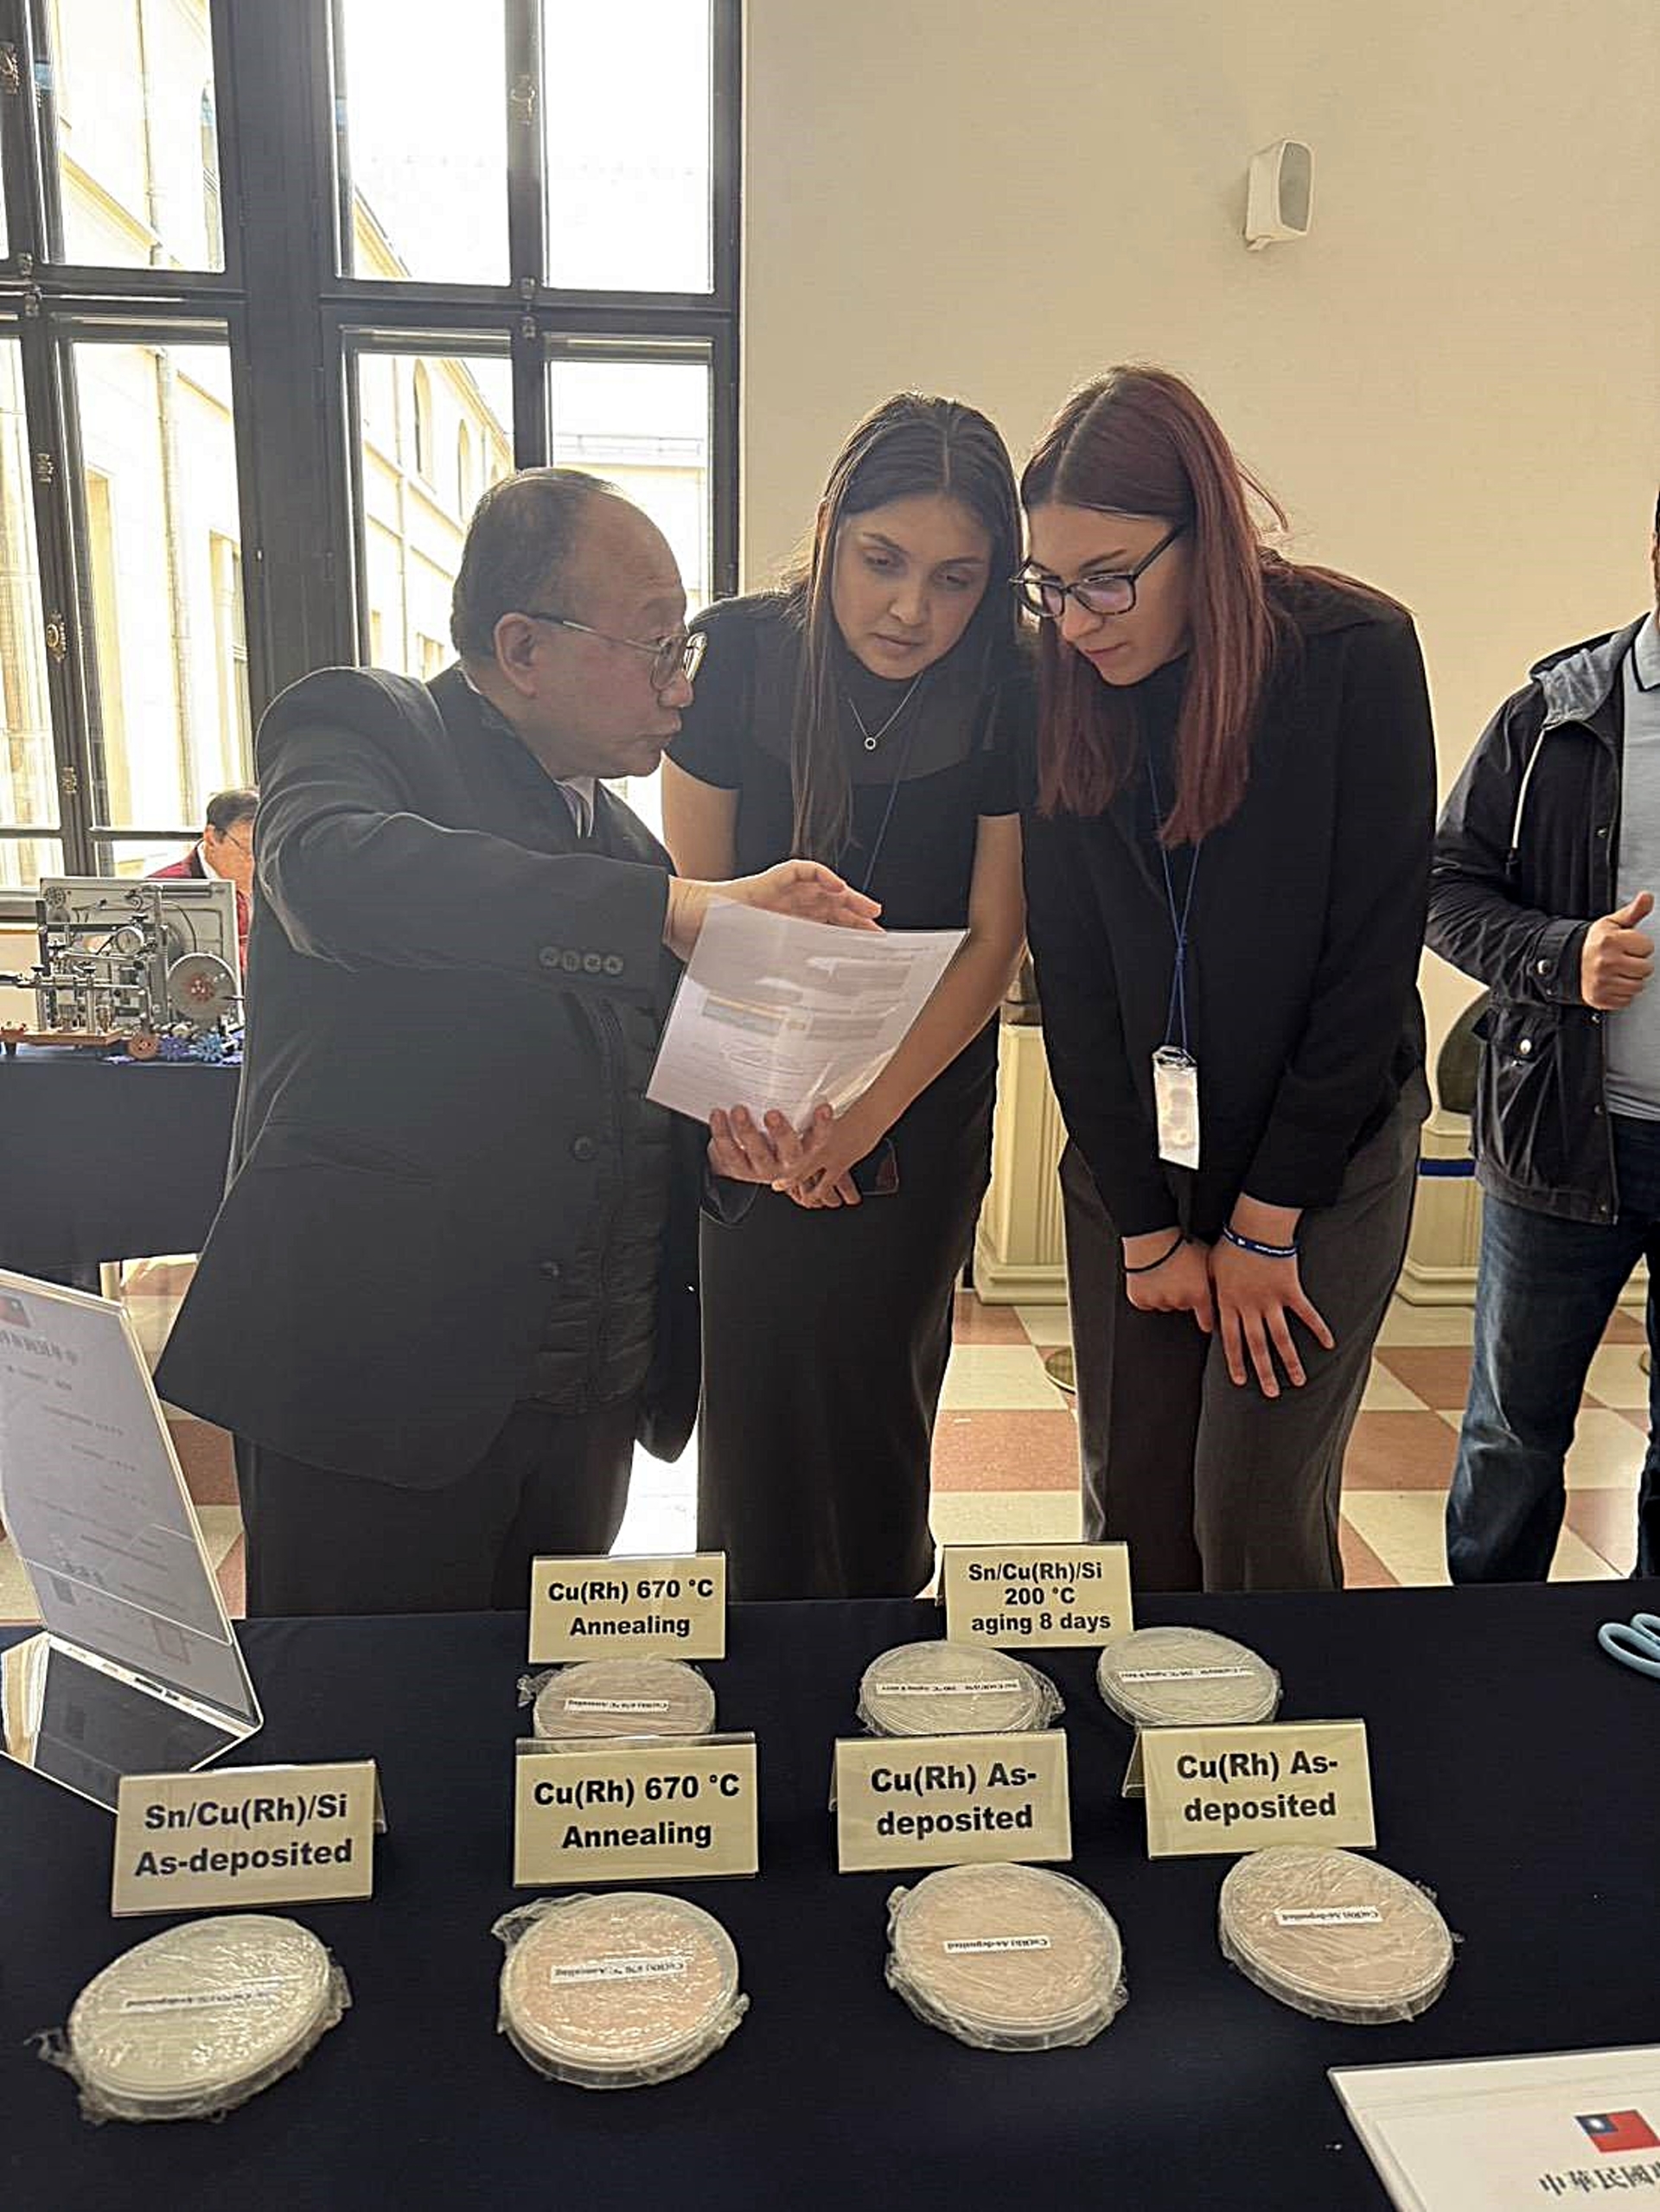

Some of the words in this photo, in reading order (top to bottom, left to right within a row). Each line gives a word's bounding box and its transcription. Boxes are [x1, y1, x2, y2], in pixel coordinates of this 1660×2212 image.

[968, 1562, 1102, 1584] Sn/Cu(Rh)/Si
[548, 1581, 629, 1604] Cu(Rh)
[636, 1579, 680, 1597] 670
[688, 1578, 713, 1597] °C
[1005, 1588, 1044, 1604] 200
[1052, 1587, 1076, 1603] °C
[570, 1616, 690, 1636] Annealing
[971, 1614, 1032, 1635] aging
[1040, 1613, 1052, 1629] 8
[1060, 1613, 1111, 1633] days
[871, 1764, 977, 1797] Cu(Rh)
[987, 1763, 1037, 1788] As-
[1177, 1751, 1280, 1783] Cu(Rh)
[1290, 1750, 1338, 1775] As-
[533, 1778, 635, 1810] Cu(Rh)
[645, 1775, 699, 1800] 670
[709, 1774, 740, 1797] °C
[144, 1793, 348, 1830] Sn/Cu(Rh)/Si
[877, 1804, 1033, 1839] deposited
[1184, 1792, 1337, 1826] deposited
[562, 1821, 712, 1849] Annealing
[134, 1839, 353, 1877] As-deposited
